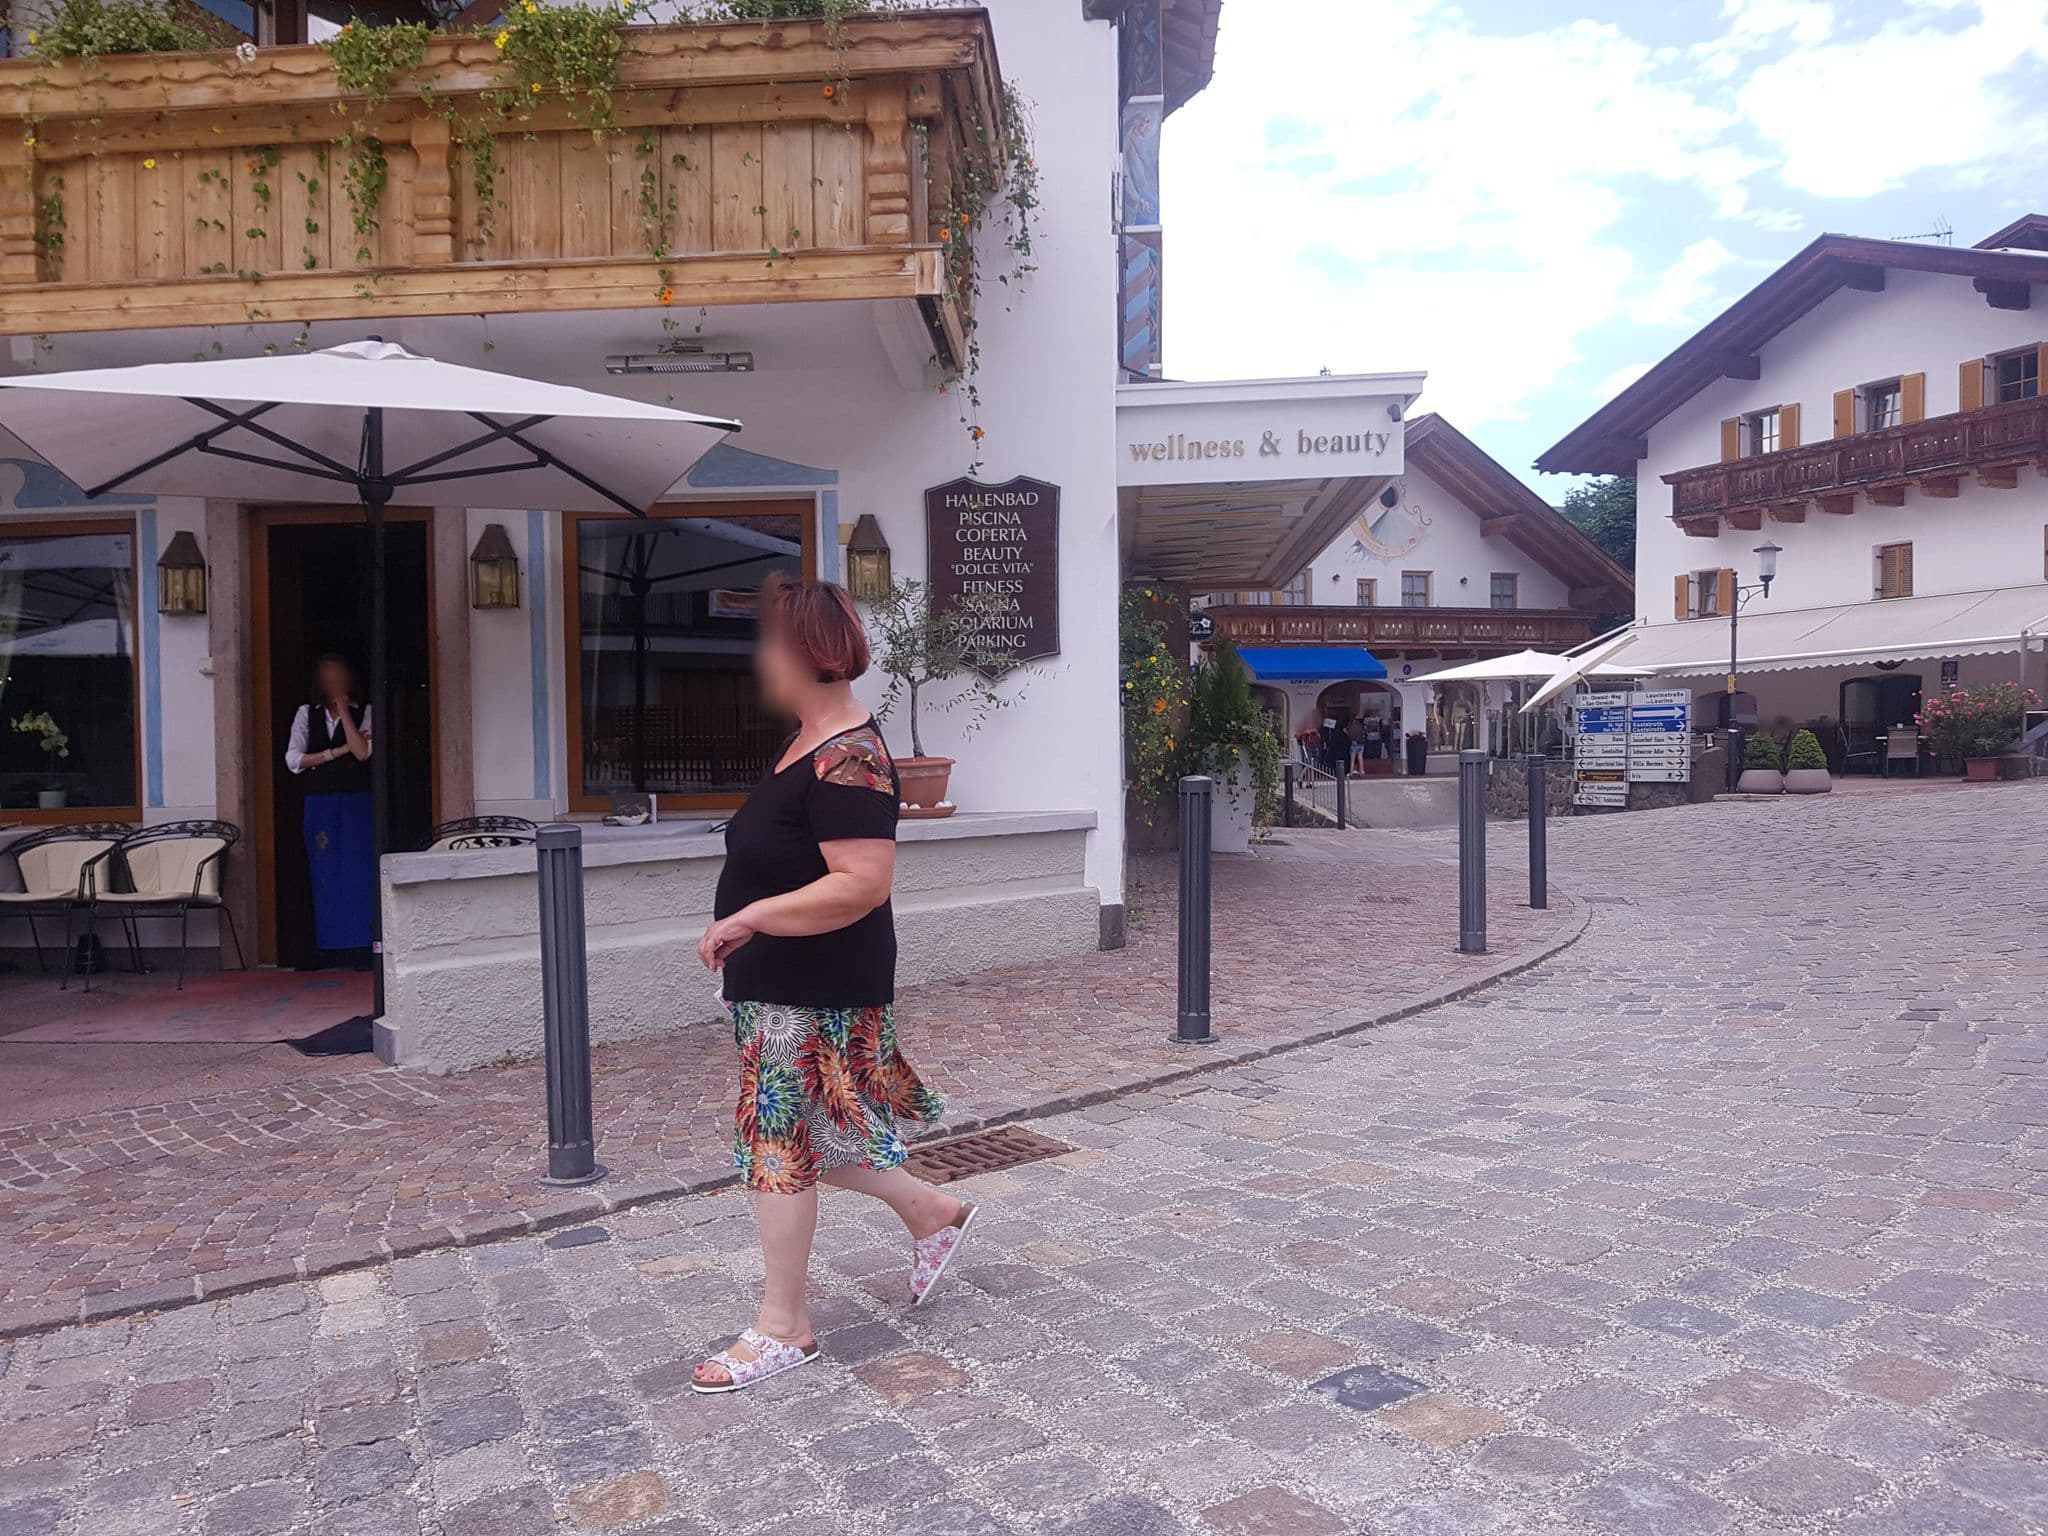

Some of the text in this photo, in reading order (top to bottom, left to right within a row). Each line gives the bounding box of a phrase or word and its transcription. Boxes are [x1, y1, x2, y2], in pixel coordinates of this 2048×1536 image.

[1129, 428, 1390, 462] wellness & beauty
[946, 492, 1039, 508] HALLENBAD
[959, 512, 1021, 526] PISCINA
[955, 528, 1027, 542] COPERTA
[963, 547, 1023, 561] BEAUTY
[963, 580, 1023, 594] FITNESS
[950, 616, 1034, 631] SOLARIUM
[958, 634, 1026, 649] PARKING
